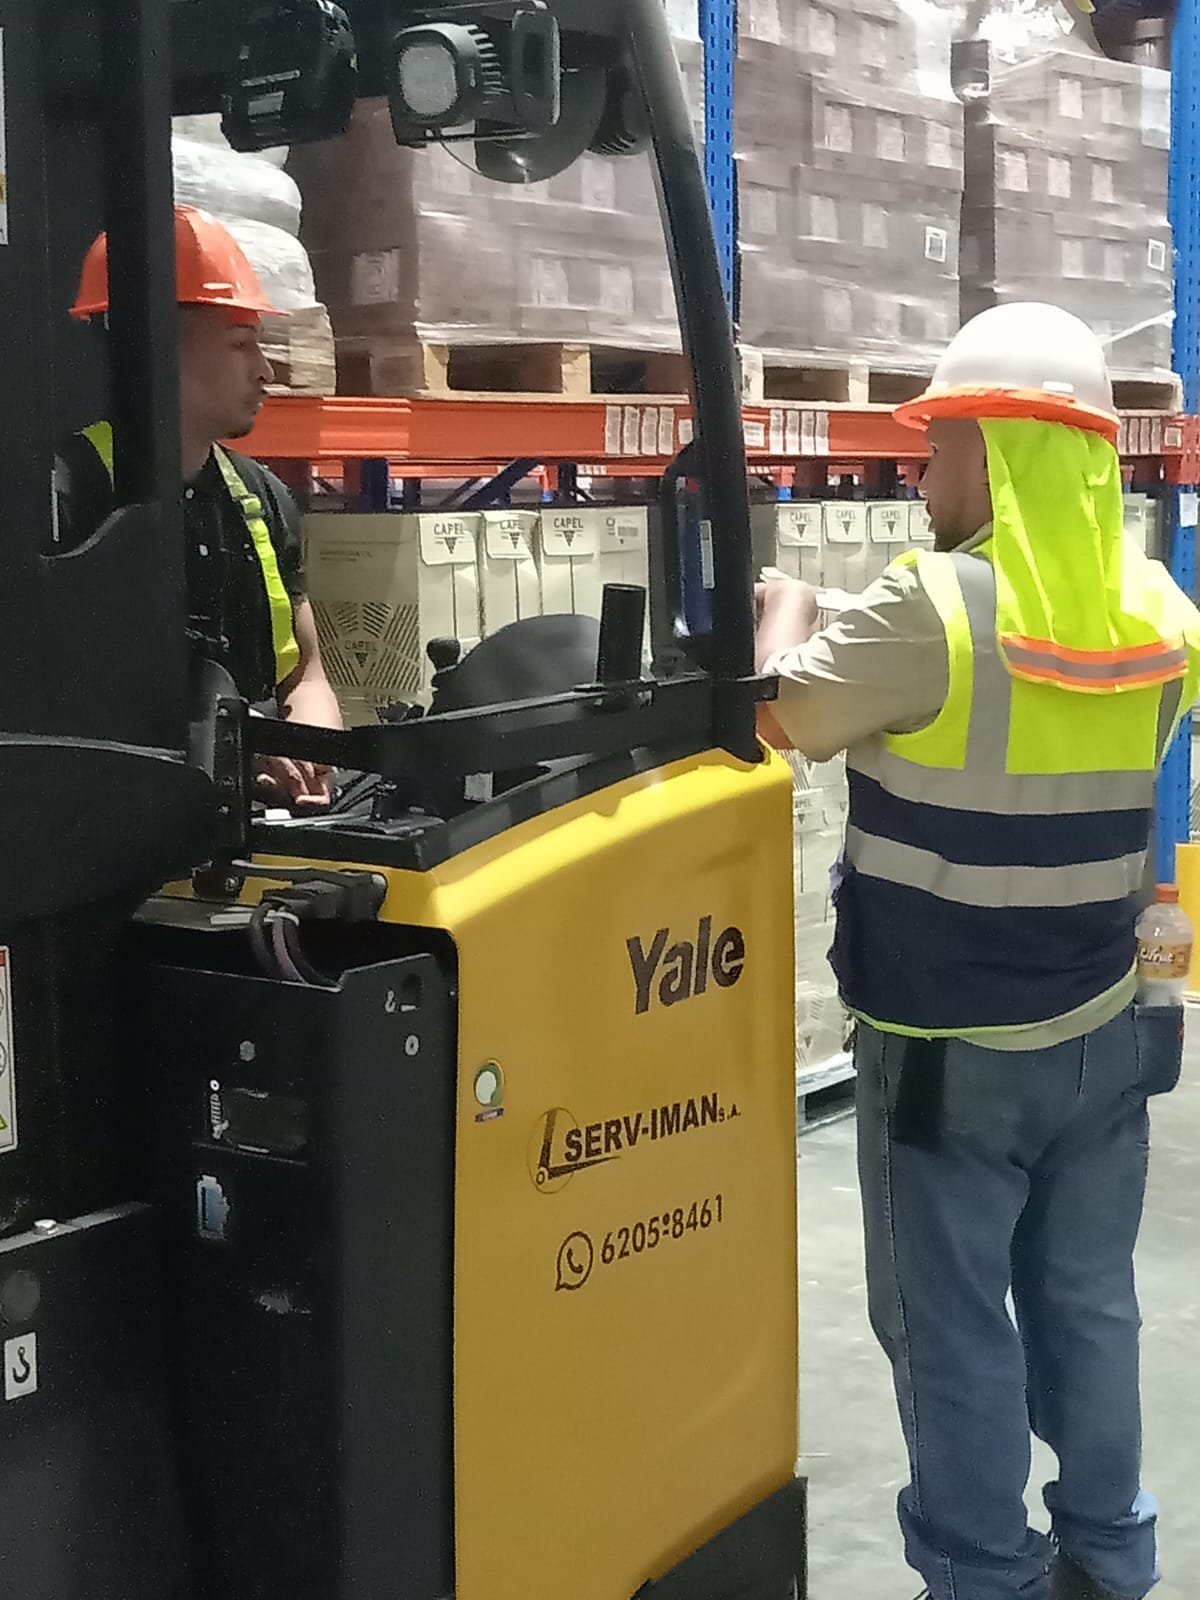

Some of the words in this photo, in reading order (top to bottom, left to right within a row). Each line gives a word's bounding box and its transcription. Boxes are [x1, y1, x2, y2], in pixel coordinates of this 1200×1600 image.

[433, 522, 466, 536] CAPEL
[553, 517, 584, 529] CAPEL
[344, 640, 377, 652] CAPEL
[626, 914, 745, 1015] Yale
[565, 1092, 718, 1163] SERV-IMAN
